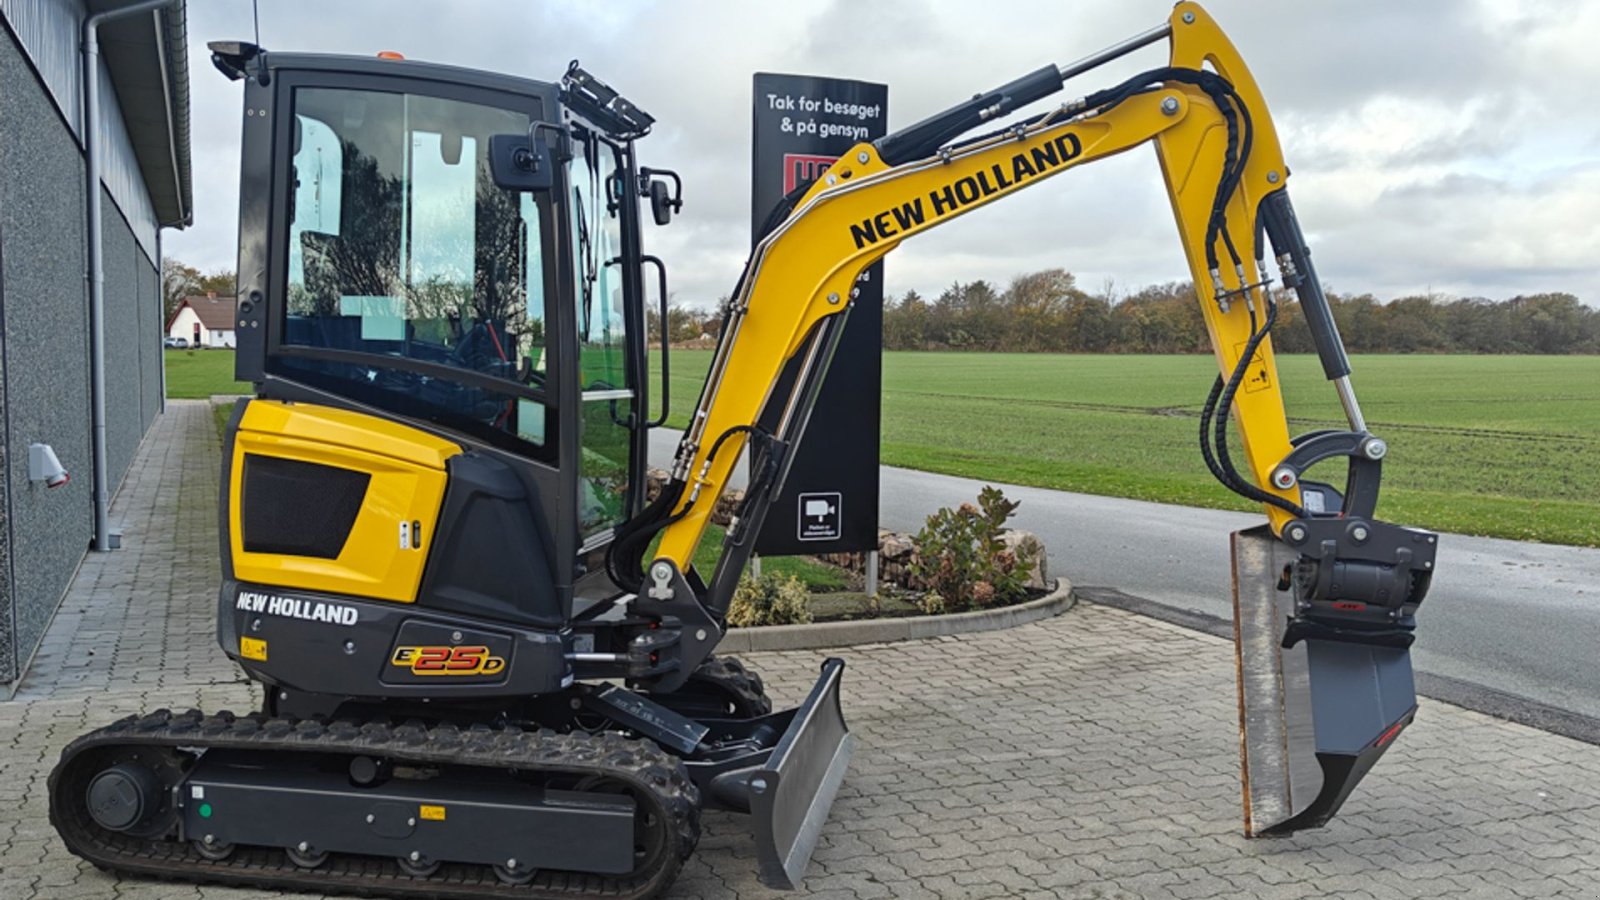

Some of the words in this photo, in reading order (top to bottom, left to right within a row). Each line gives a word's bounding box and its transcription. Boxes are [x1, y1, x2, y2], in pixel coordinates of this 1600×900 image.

[767, 94, 795, 110] Tak
[799, 96, 821, 112] for
[824, 97, 880, 120] besøget
[781, 117, 793, 132] &
[797, 118, 817, 136] på
[819, 123, 869, 140] gensyn
[850, 197, 925, 250] NEW
[929, 132, 1082, 216] HOLLAND
[236, 591, 268, 613] NEW
[267, 596, 358, 626] HOLLAND
